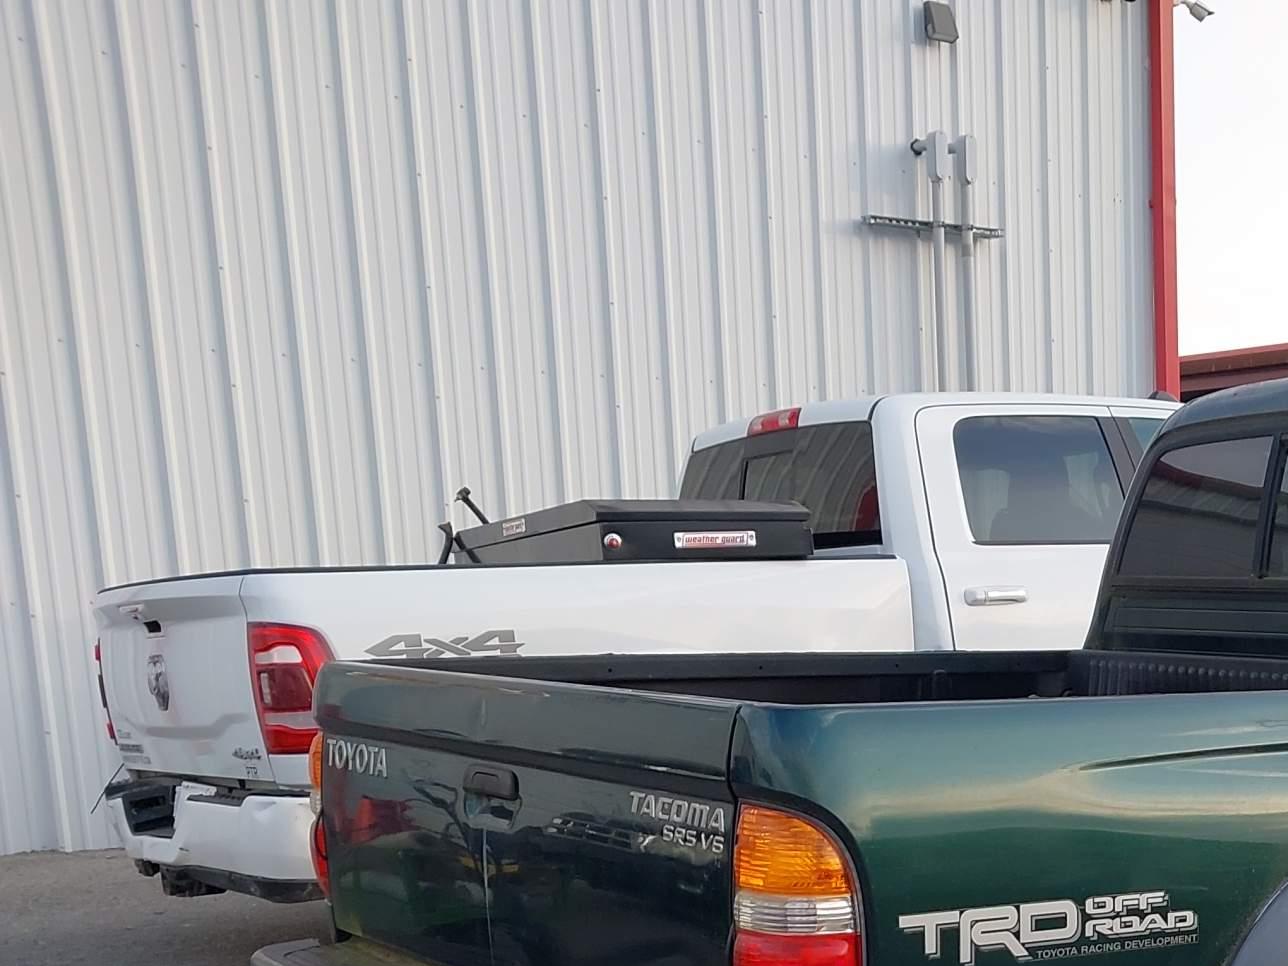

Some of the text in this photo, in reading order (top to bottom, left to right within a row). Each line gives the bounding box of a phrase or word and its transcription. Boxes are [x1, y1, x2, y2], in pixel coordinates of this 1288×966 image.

[685, 535, 745, 544] weather guard
[326, 738, 388, 778] TOYOTA
[629, 791, 725, 833] TACOMA
[700, 832, 725, 853] V6
[1085, 891, 1168, 916] OFF
[1085, 910, 1198, 940] ROAD
[1036, 934, 1198, 959] TOYOTA RACING DEVELOPMENT
